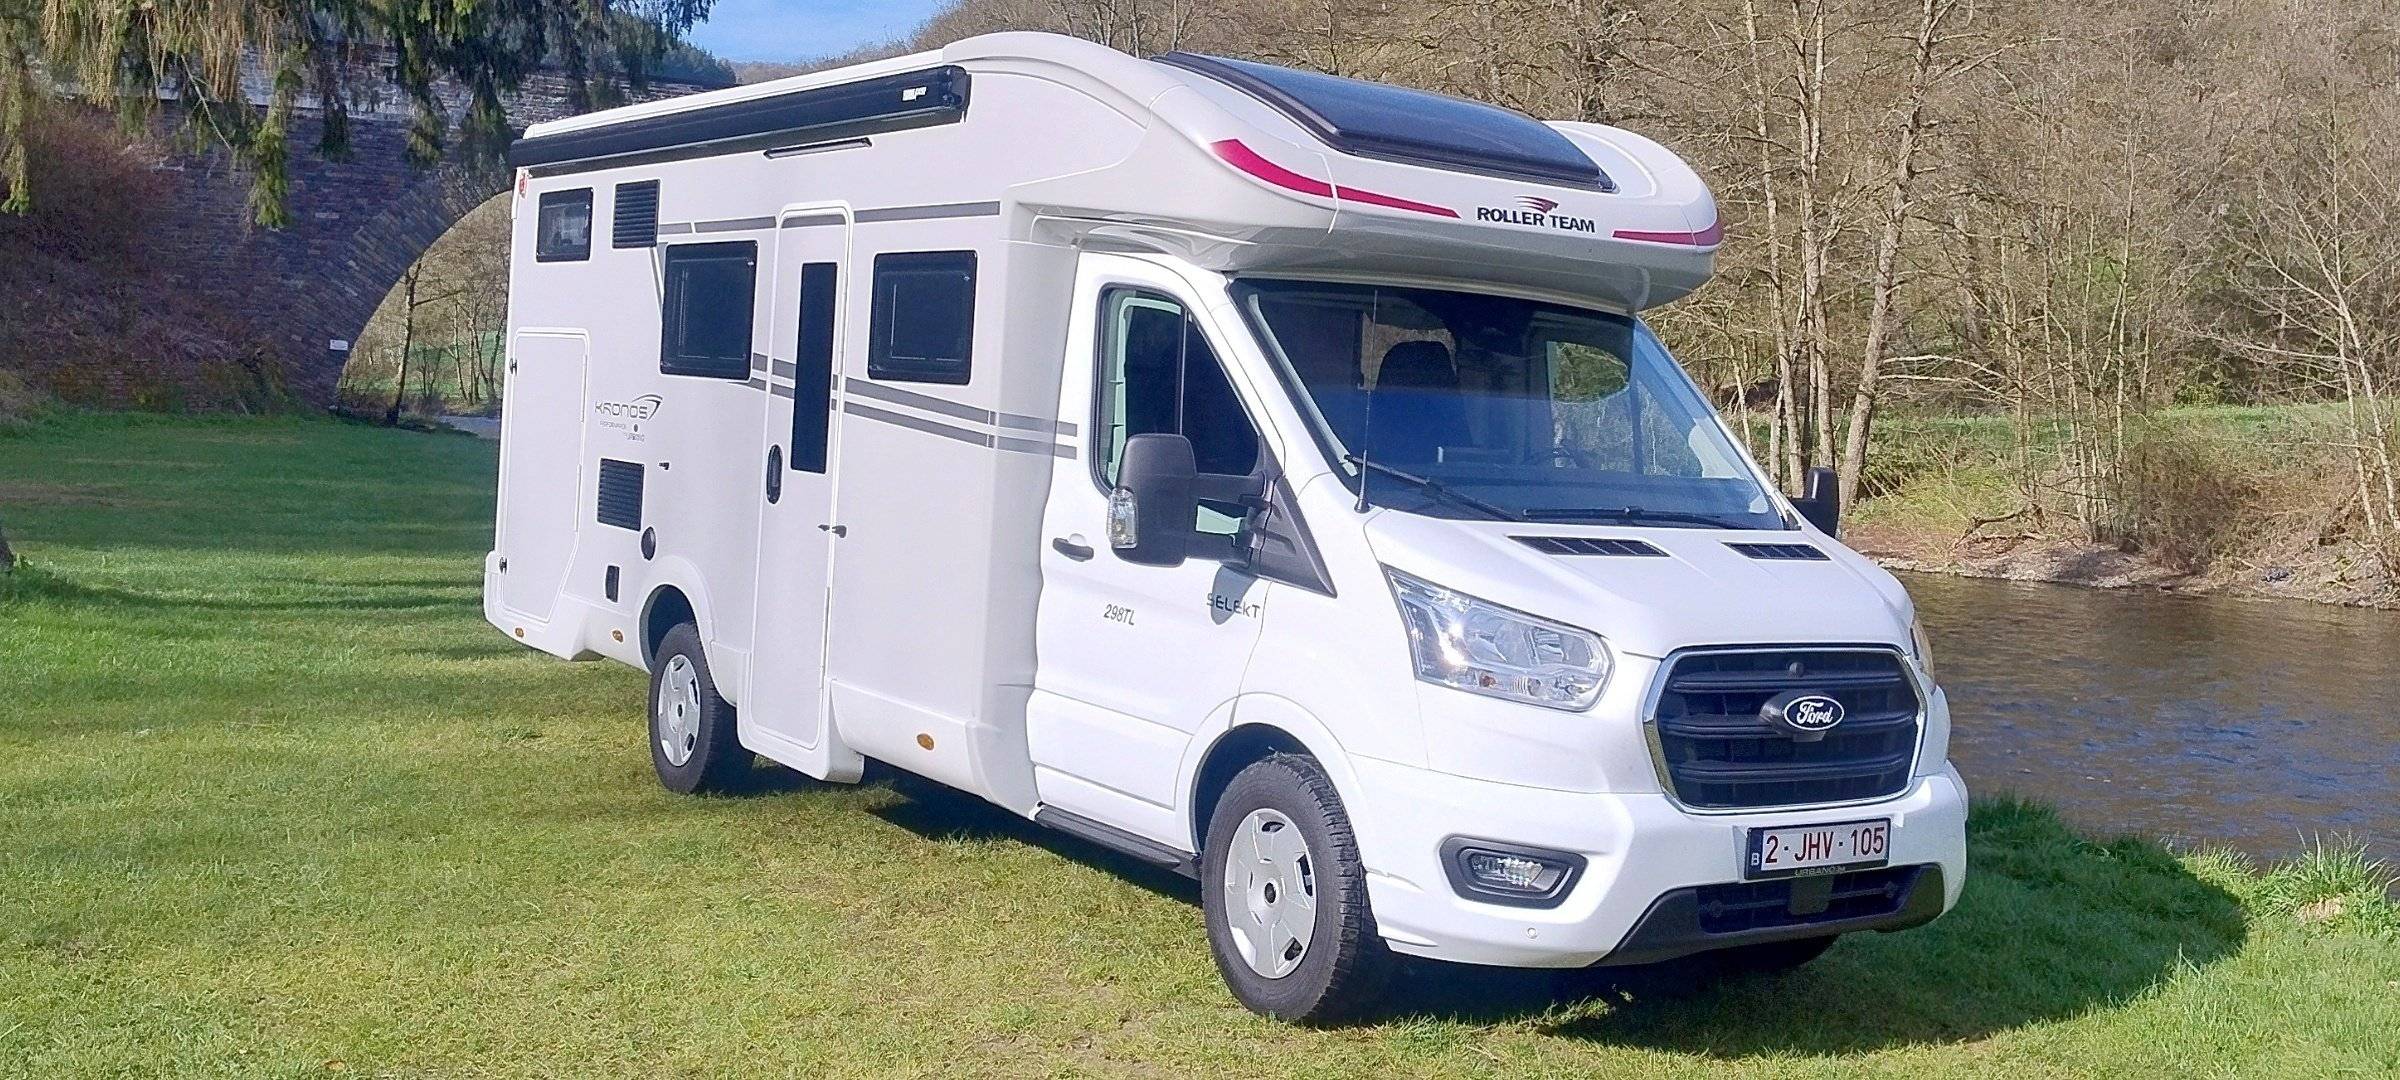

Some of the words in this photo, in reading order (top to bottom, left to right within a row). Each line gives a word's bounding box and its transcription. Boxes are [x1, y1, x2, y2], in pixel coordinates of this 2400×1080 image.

[1477, 206, 1545, 227] ROLLER
[1550, 214, 1596, 233] TEAM
[594, 401, 648, 419] KRONOS
[1103, 603, 1135, 626] 298TL
[1796, 700, 1834, 724] Ford
[1751, 852, 1761, 866] B
